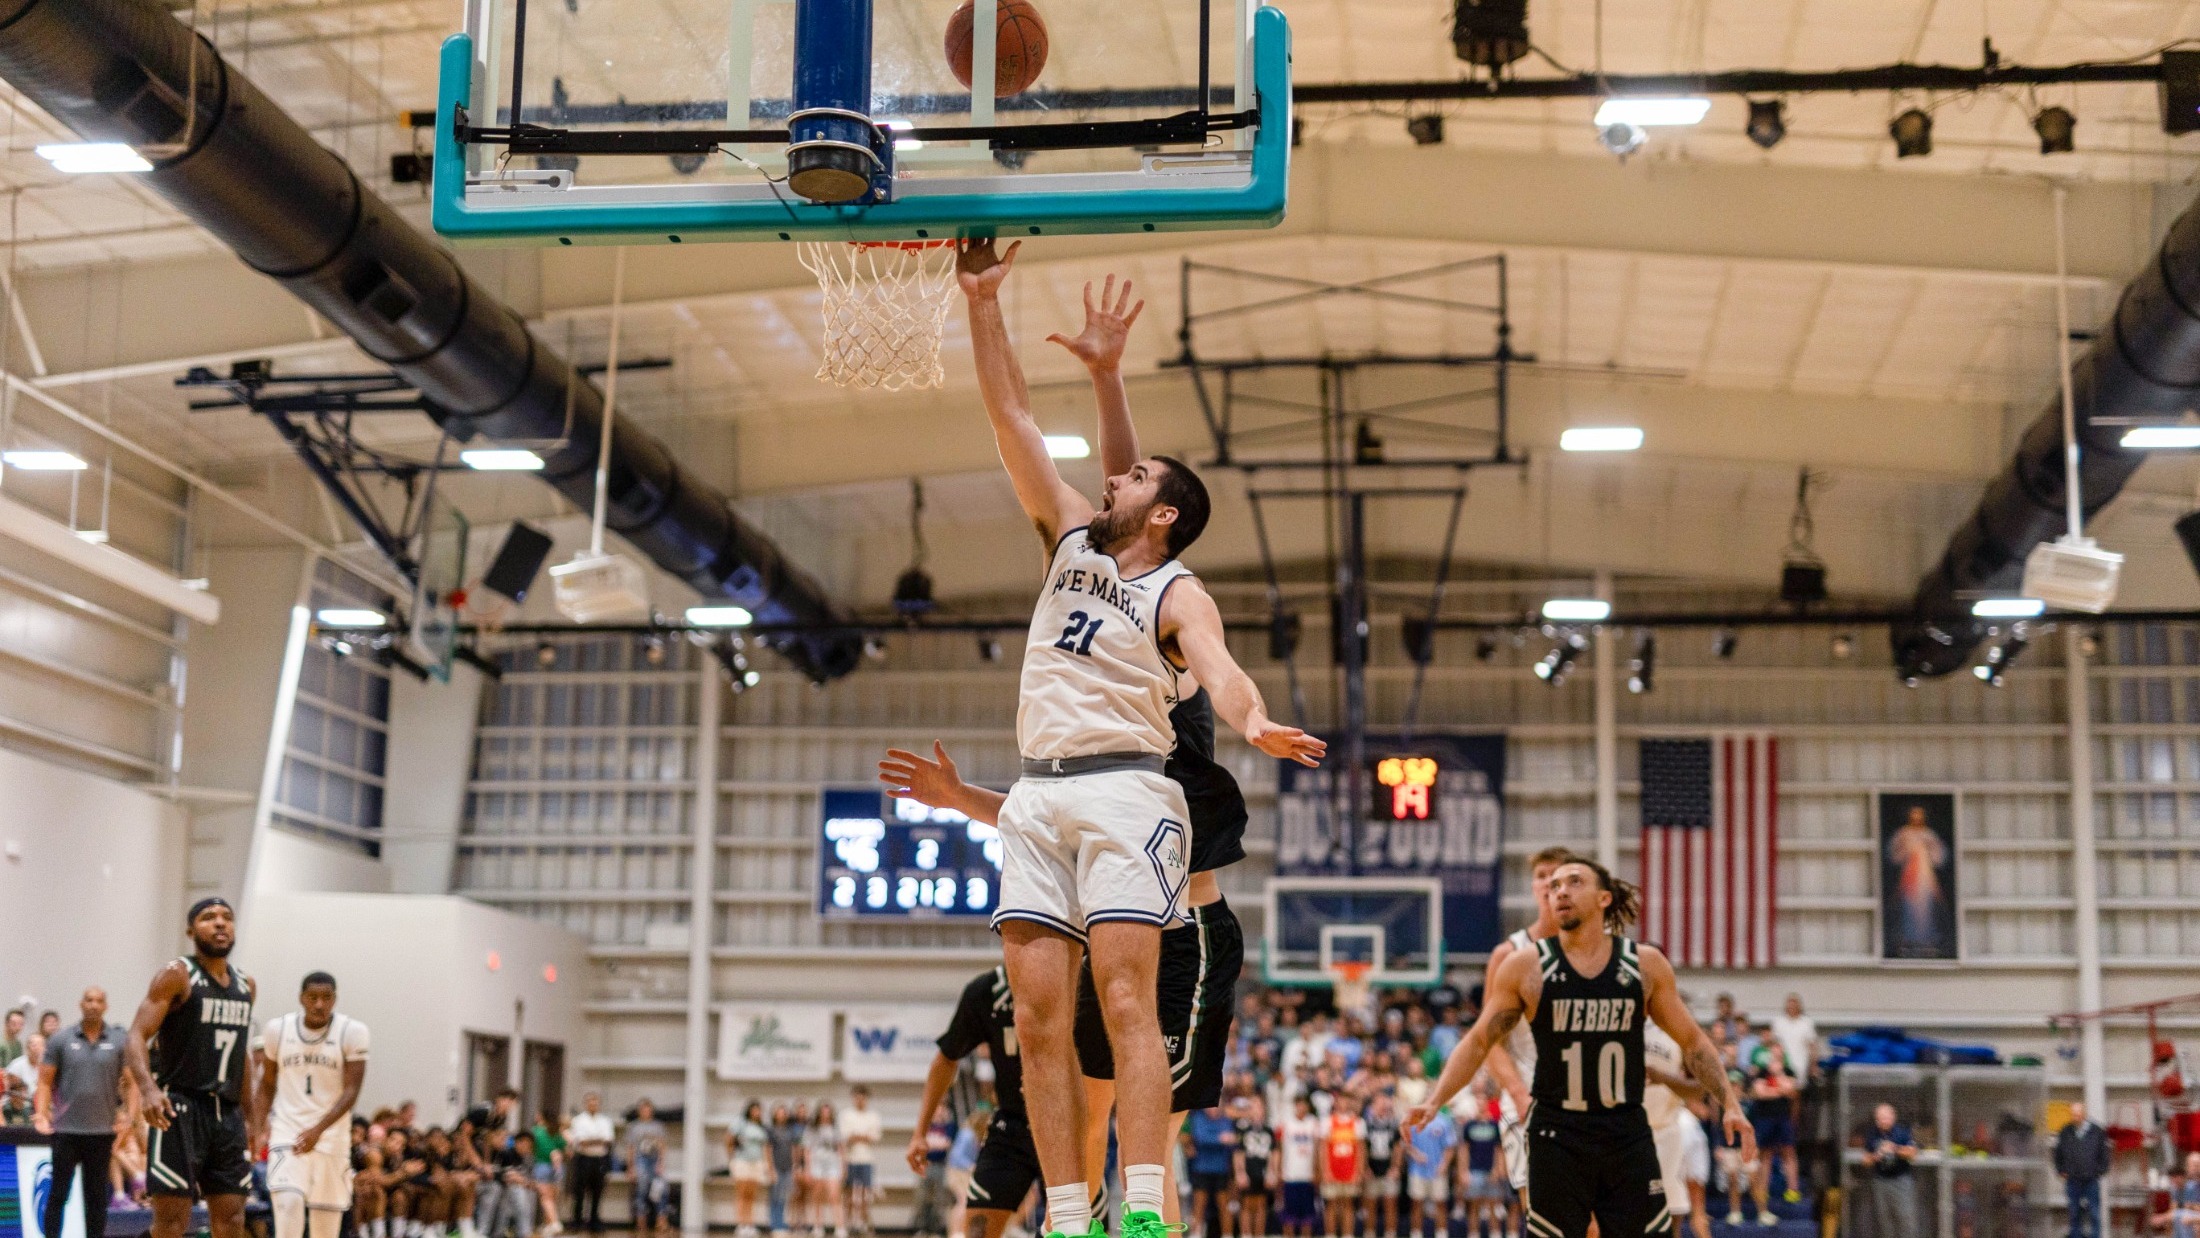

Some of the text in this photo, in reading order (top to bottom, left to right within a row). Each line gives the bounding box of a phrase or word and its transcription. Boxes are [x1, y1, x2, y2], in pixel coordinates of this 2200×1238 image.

[1054, 610, 1104, 656] 21
[1552, 999, 1635, 1031] WEBBER
[214, 1029, 238, 1083] 7
[1561, 1041, 1627, 1111] 10
[304, 1073, 313, 1096] 1
